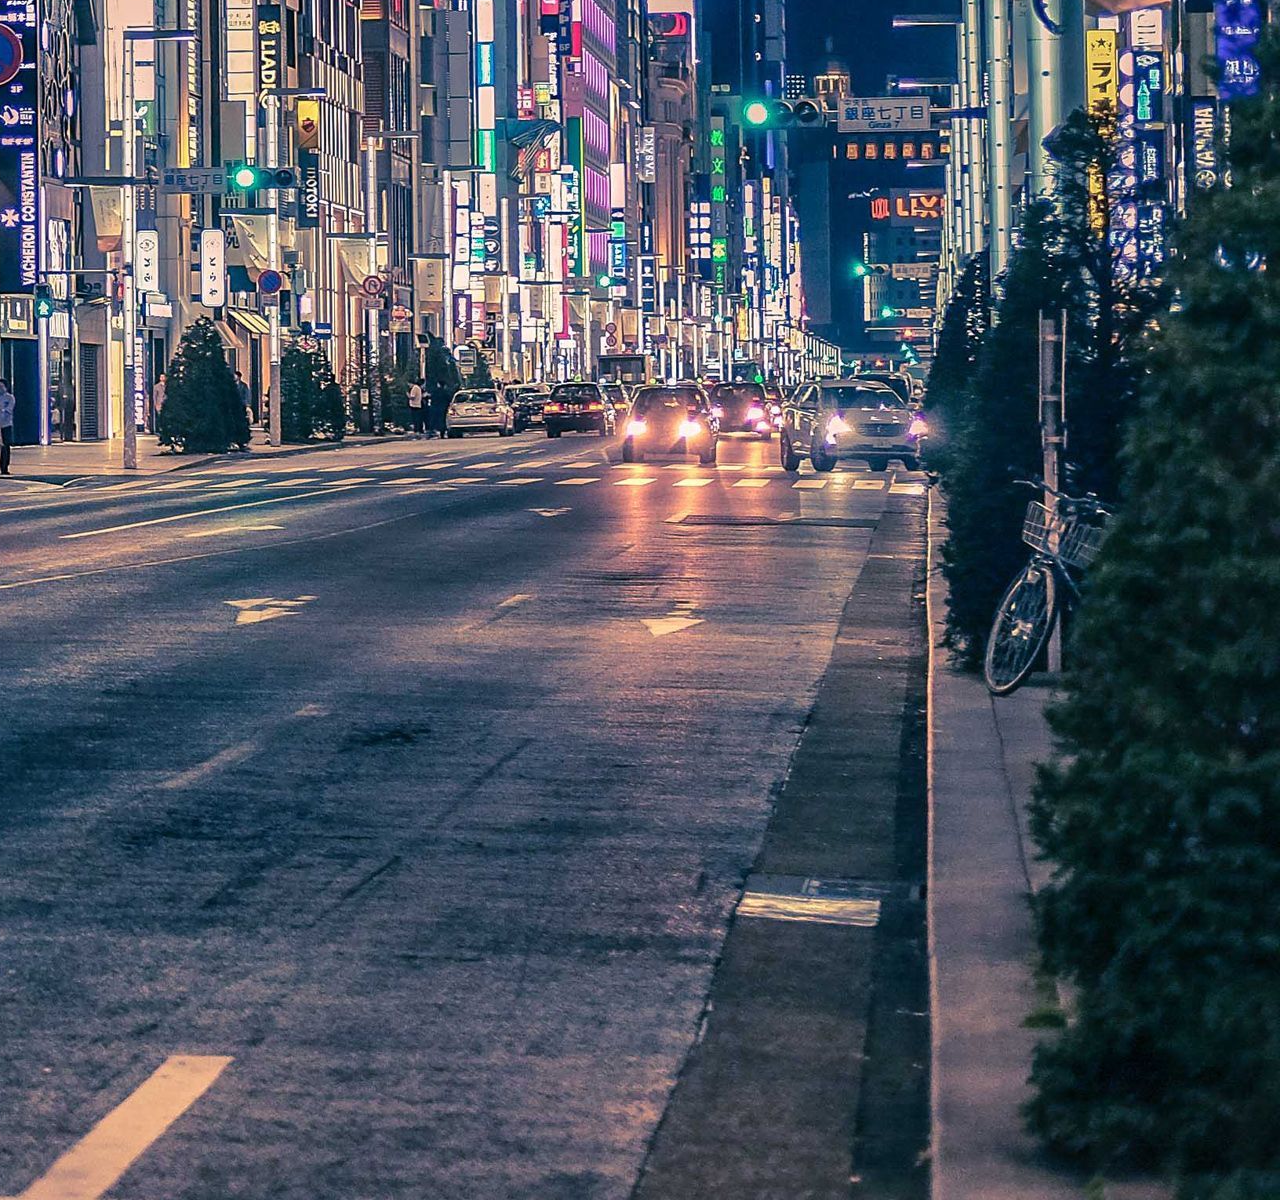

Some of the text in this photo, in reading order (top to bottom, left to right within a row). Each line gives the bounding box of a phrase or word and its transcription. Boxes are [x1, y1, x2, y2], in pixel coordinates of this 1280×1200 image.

[845, 106, 924, 121] 銀座七丁目
[1195, 106, 1214, 169] YAMAHA
[645, 133, 655, 178] TASAKI
[21, 152, 35, 286] VACHERON CONSTANTIN
